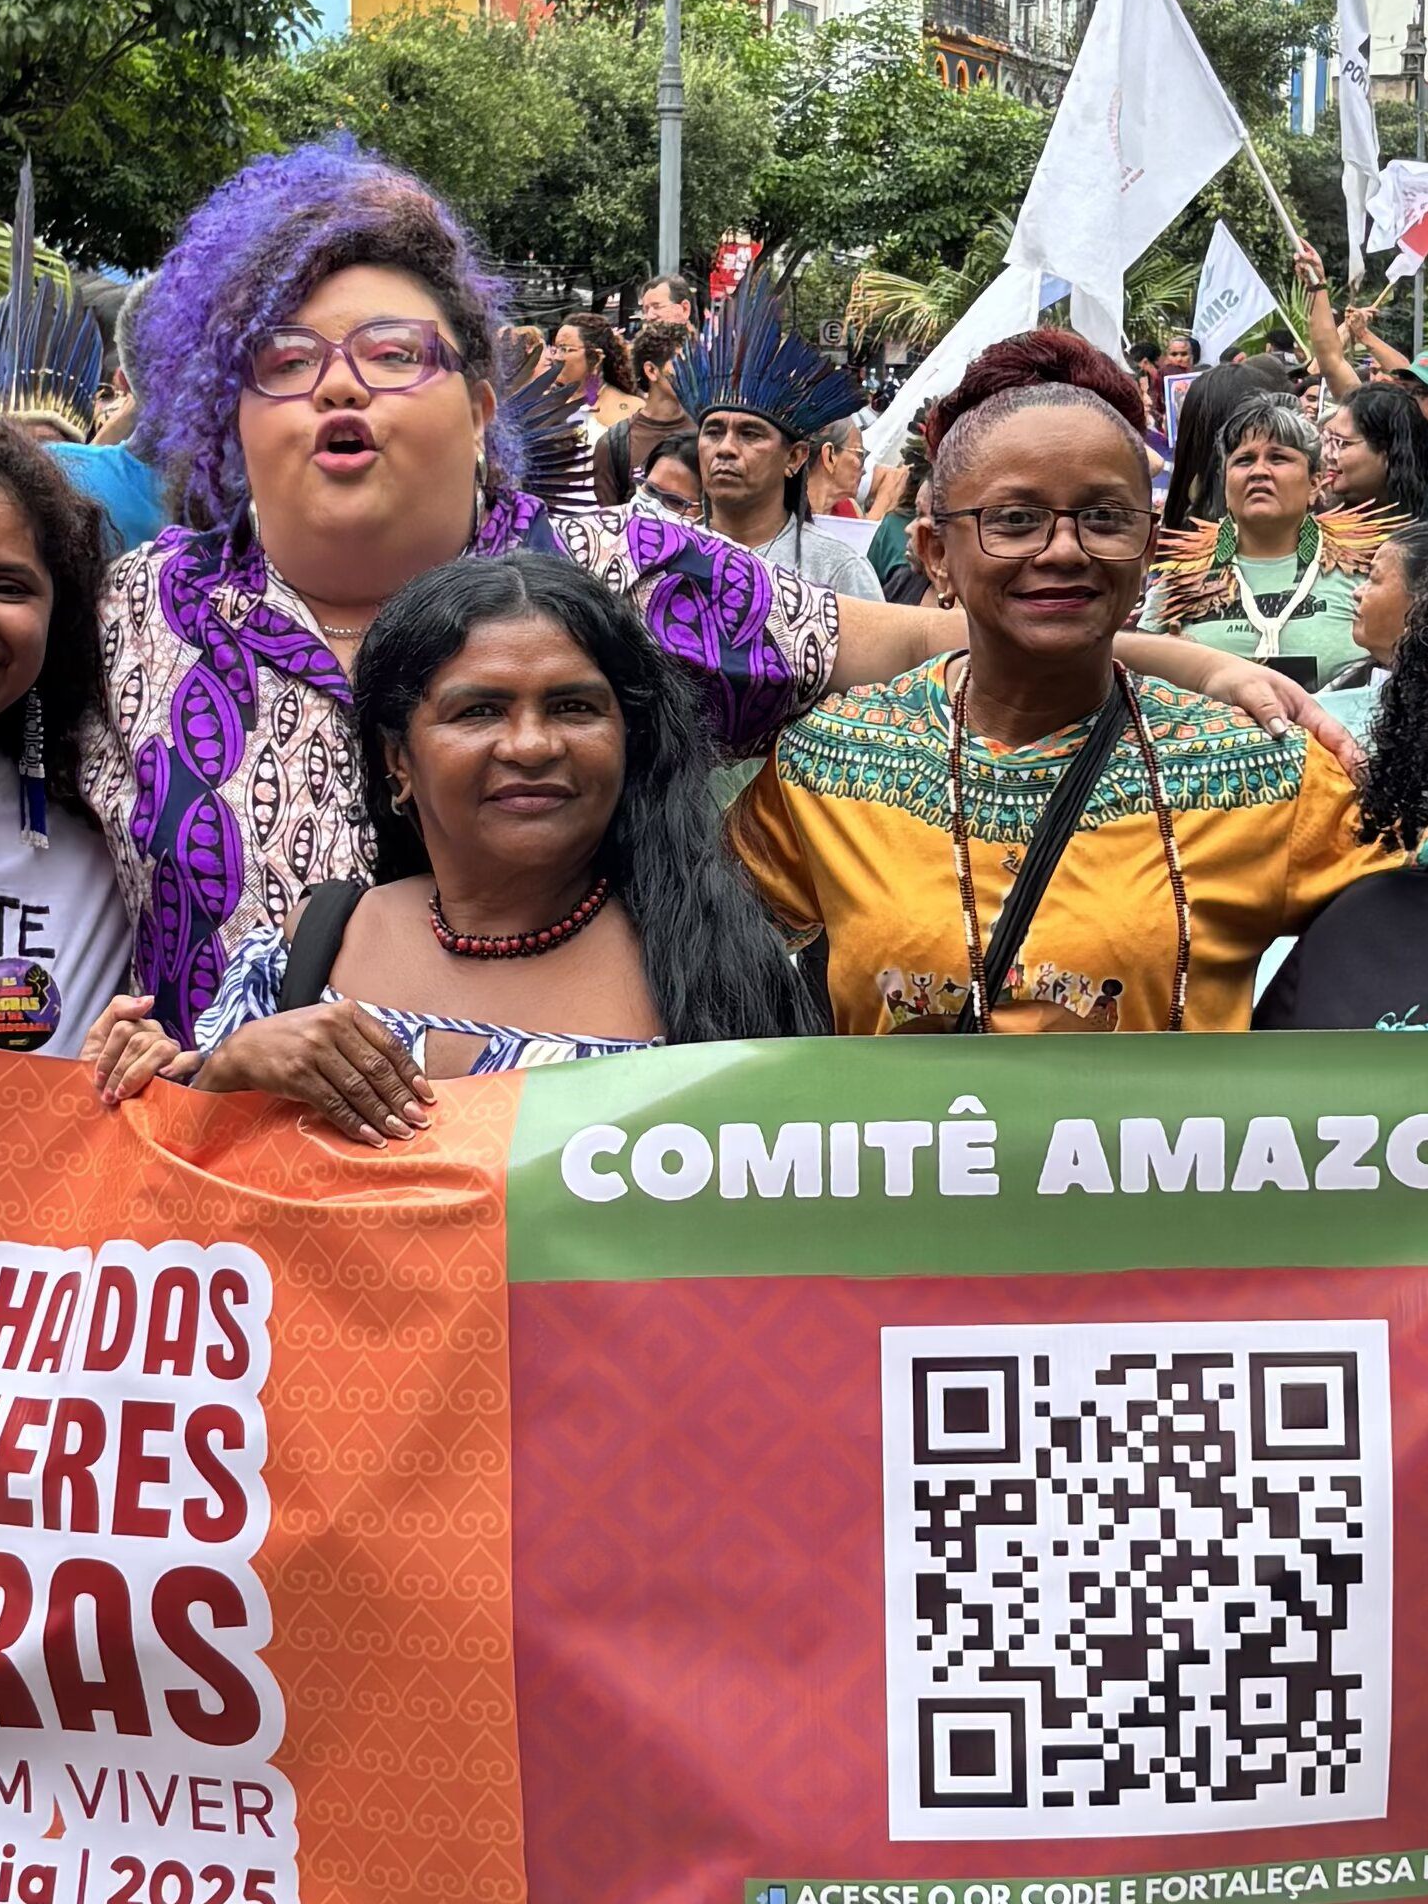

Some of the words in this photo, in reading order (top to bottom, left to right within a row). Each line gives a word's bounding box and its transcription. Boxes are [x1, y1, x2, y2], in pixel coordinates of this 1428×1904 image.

[560, 1094, 1000, 1202] COMITÊ
[83, 1264, 250, 1380] DAS
[65, 1762, 277, 1839] VIVER
[1145, 1863, 1330, 1904] FORTALEÇA
[1336, 1855, 1416, 1889] ESSA
